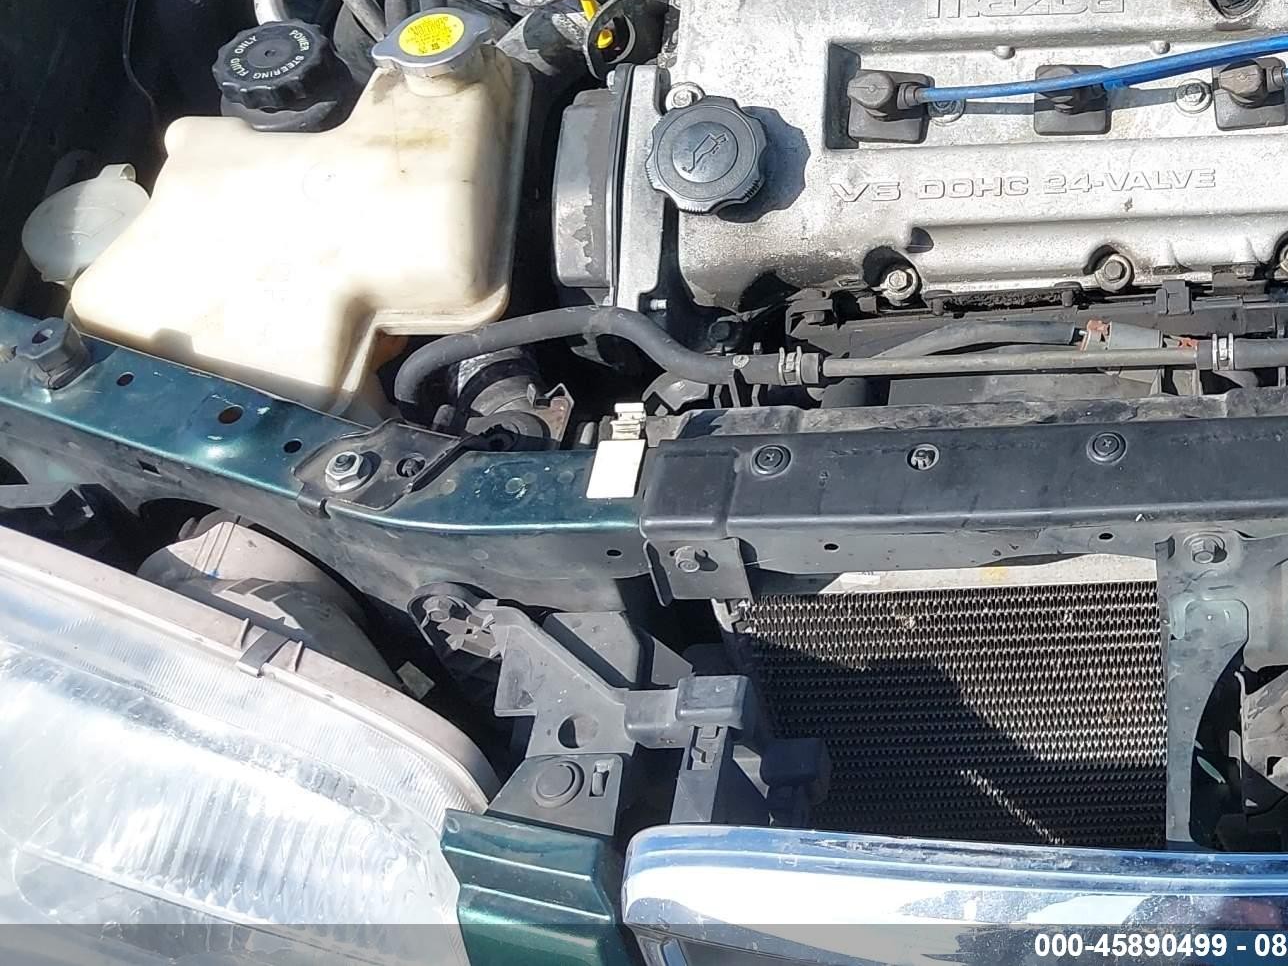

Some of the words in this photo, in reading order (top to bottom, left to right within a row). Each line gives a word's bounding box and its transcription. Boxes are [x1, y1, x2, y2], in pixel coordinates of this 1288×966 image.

[234, 35, 258, 54] ONLY
[288, 29, 310, 52] POWER
[230, 57, 250, 77] FLUID
[252, 55, 305, 80] STEERING
[917, 175, 1030, 201] DOHC
[1043, 168, 1217, 195] 24-VALVE
